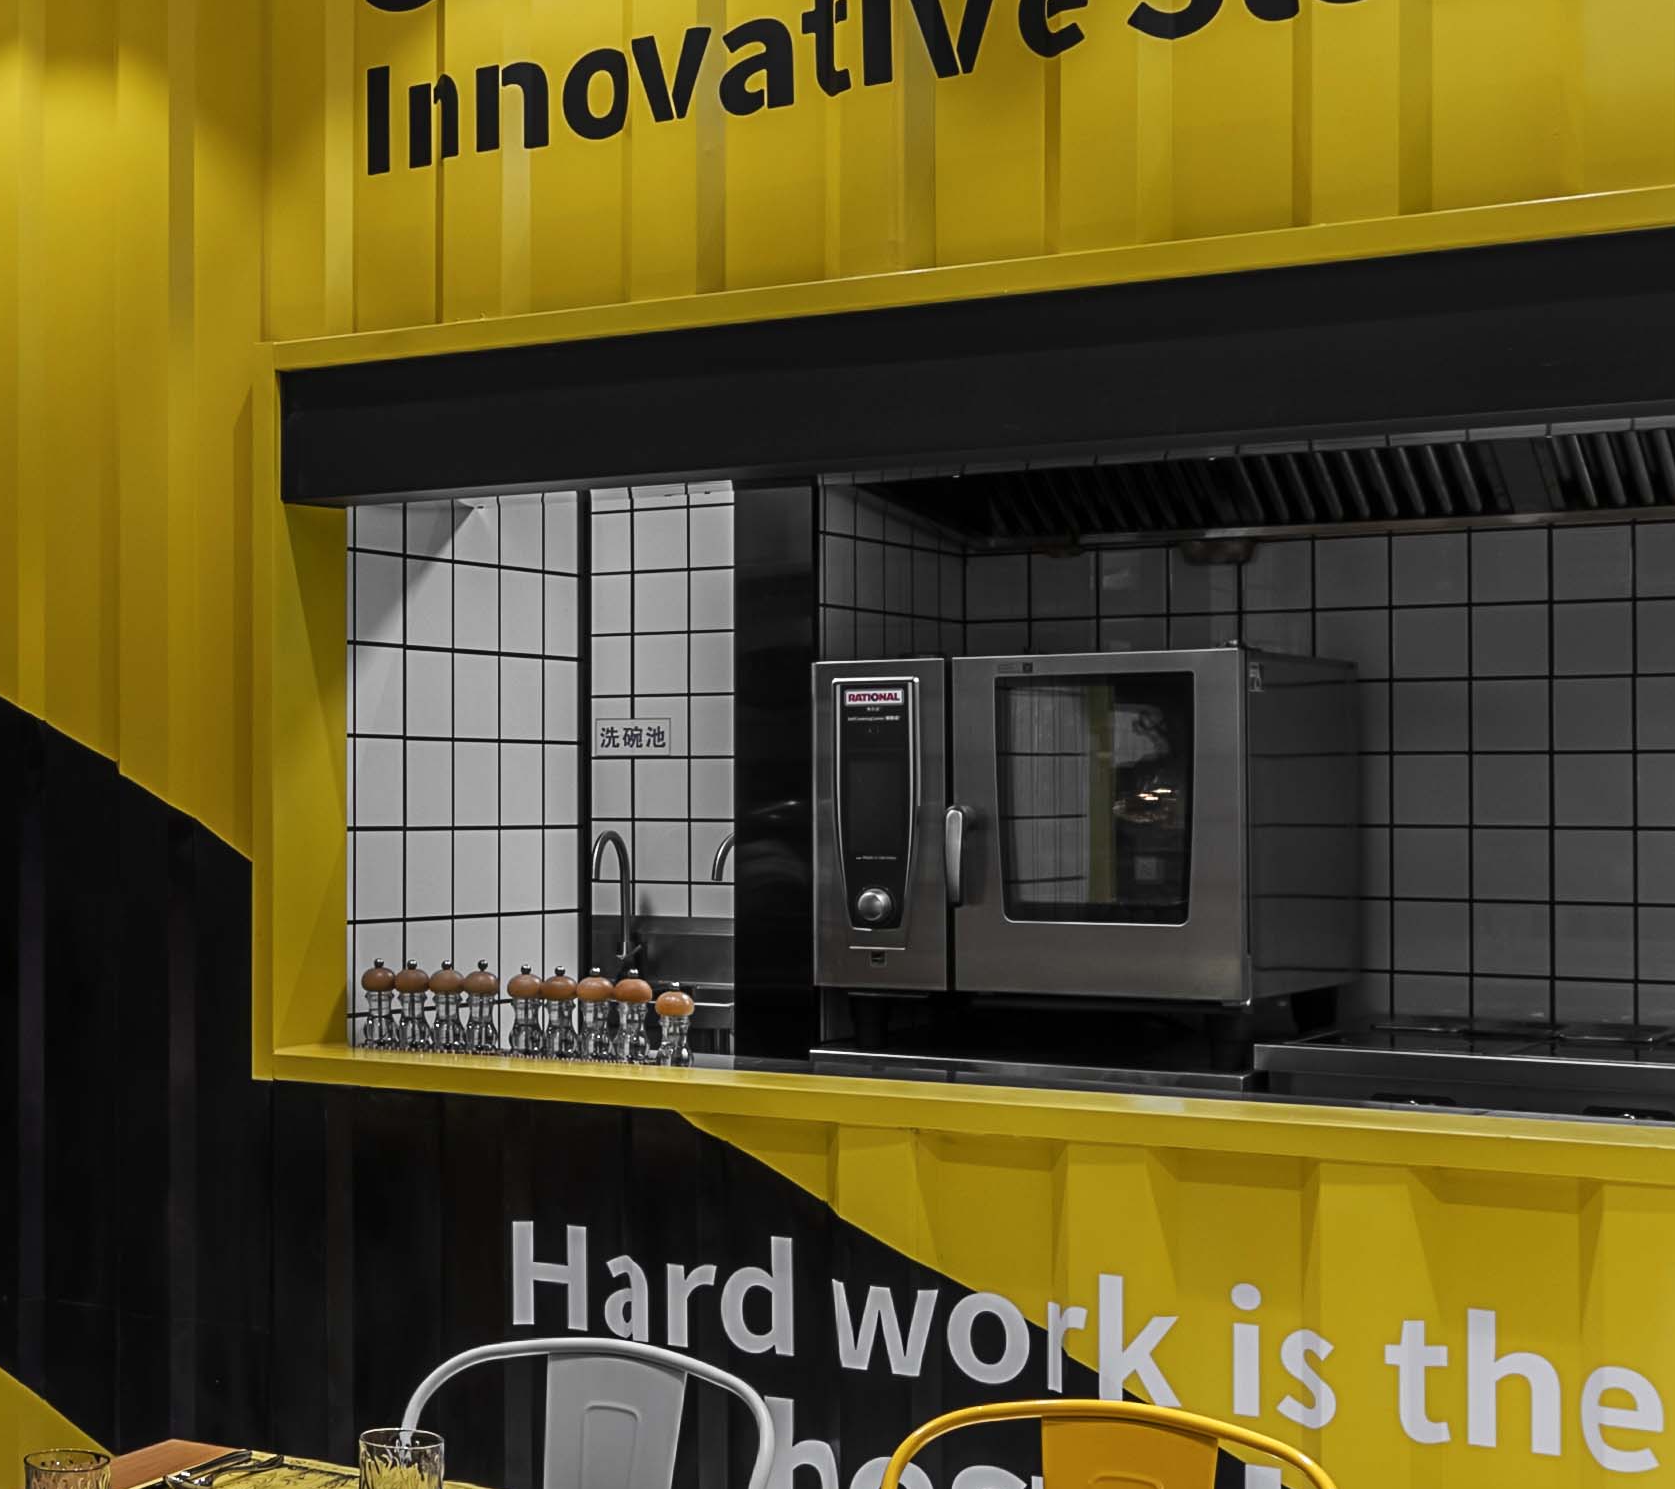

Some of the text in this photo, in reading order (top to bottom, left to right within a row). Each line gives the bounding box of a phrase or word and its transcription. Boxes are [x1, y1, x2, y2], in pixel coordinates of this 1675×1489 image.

[847, 692, 900, 703] RATIONAL
[599, 726, 667, 750] 洗碗池
[512, 1220, 1664, 1473] Hard work is the
